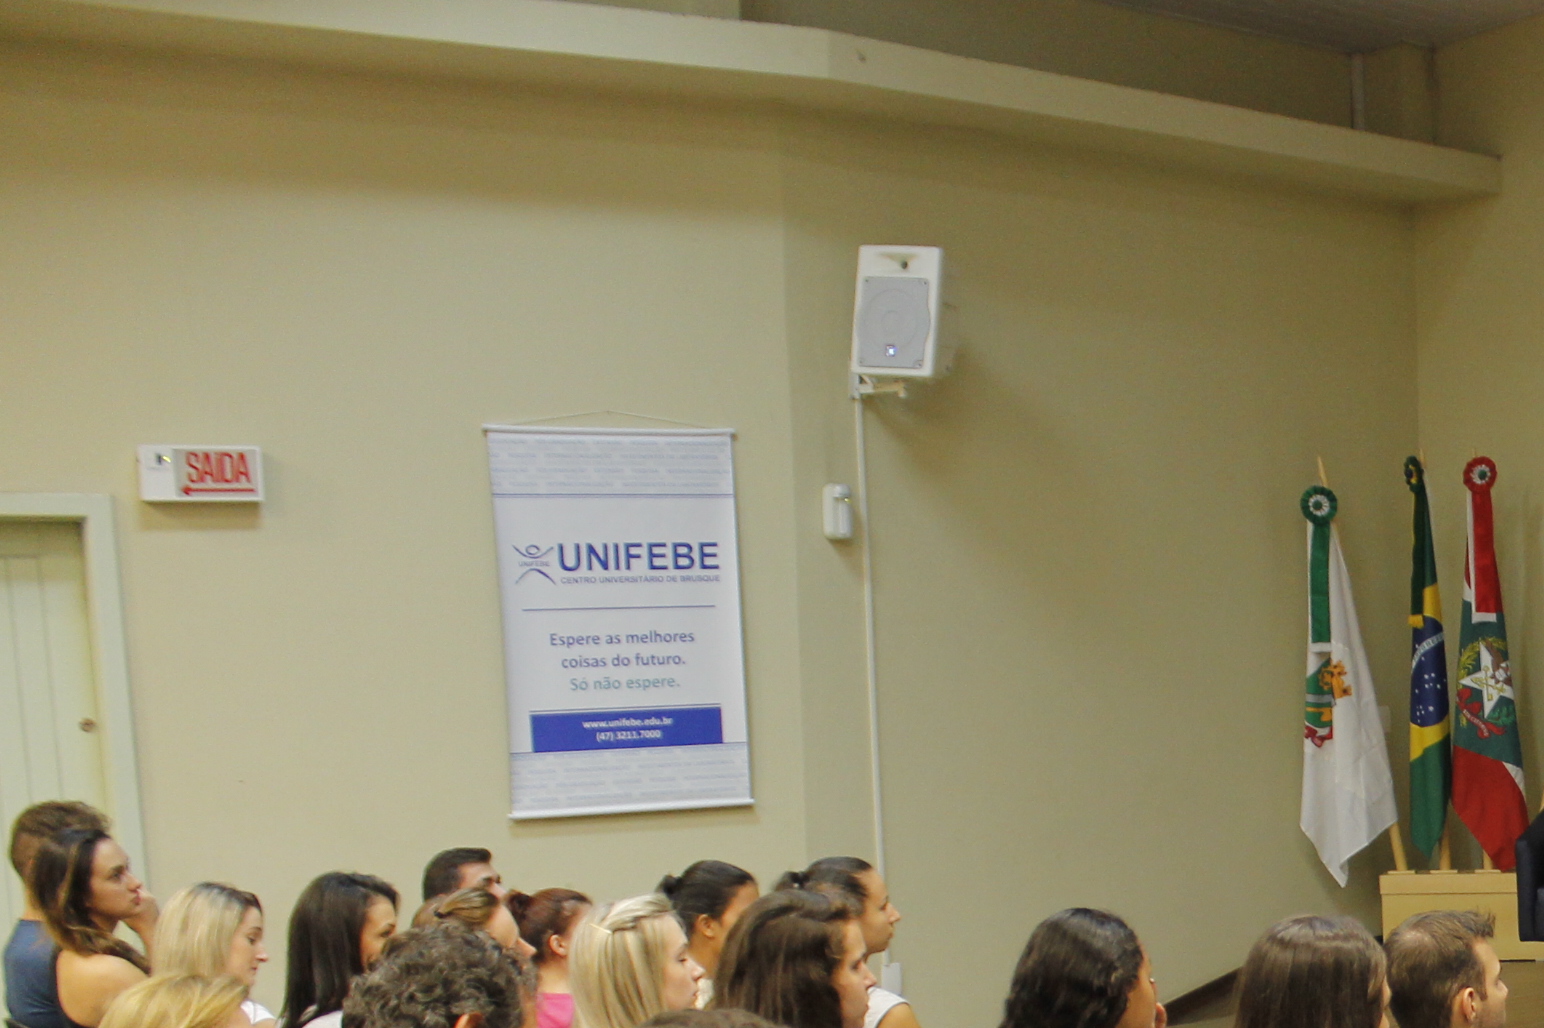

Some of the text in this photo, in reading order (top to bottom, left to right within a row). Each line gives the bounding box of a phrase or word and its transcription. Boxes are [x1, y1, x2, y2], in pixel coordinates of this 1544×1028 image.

[557, 541, 720, 572] UNIFEBE
[560, 574, 721, 585] CENTRO UNIVERSITÁRIO DE BRUSQUE
[549, 630, 695, 649] Espere as melhores
[561, 652, 686, 669] coisas do futuro.
[570, 676, 681, 692] Só não espere.
[582, 716, 674, 729] www.unifebe.edu.br
[596, 730, 614, 742] (47)
